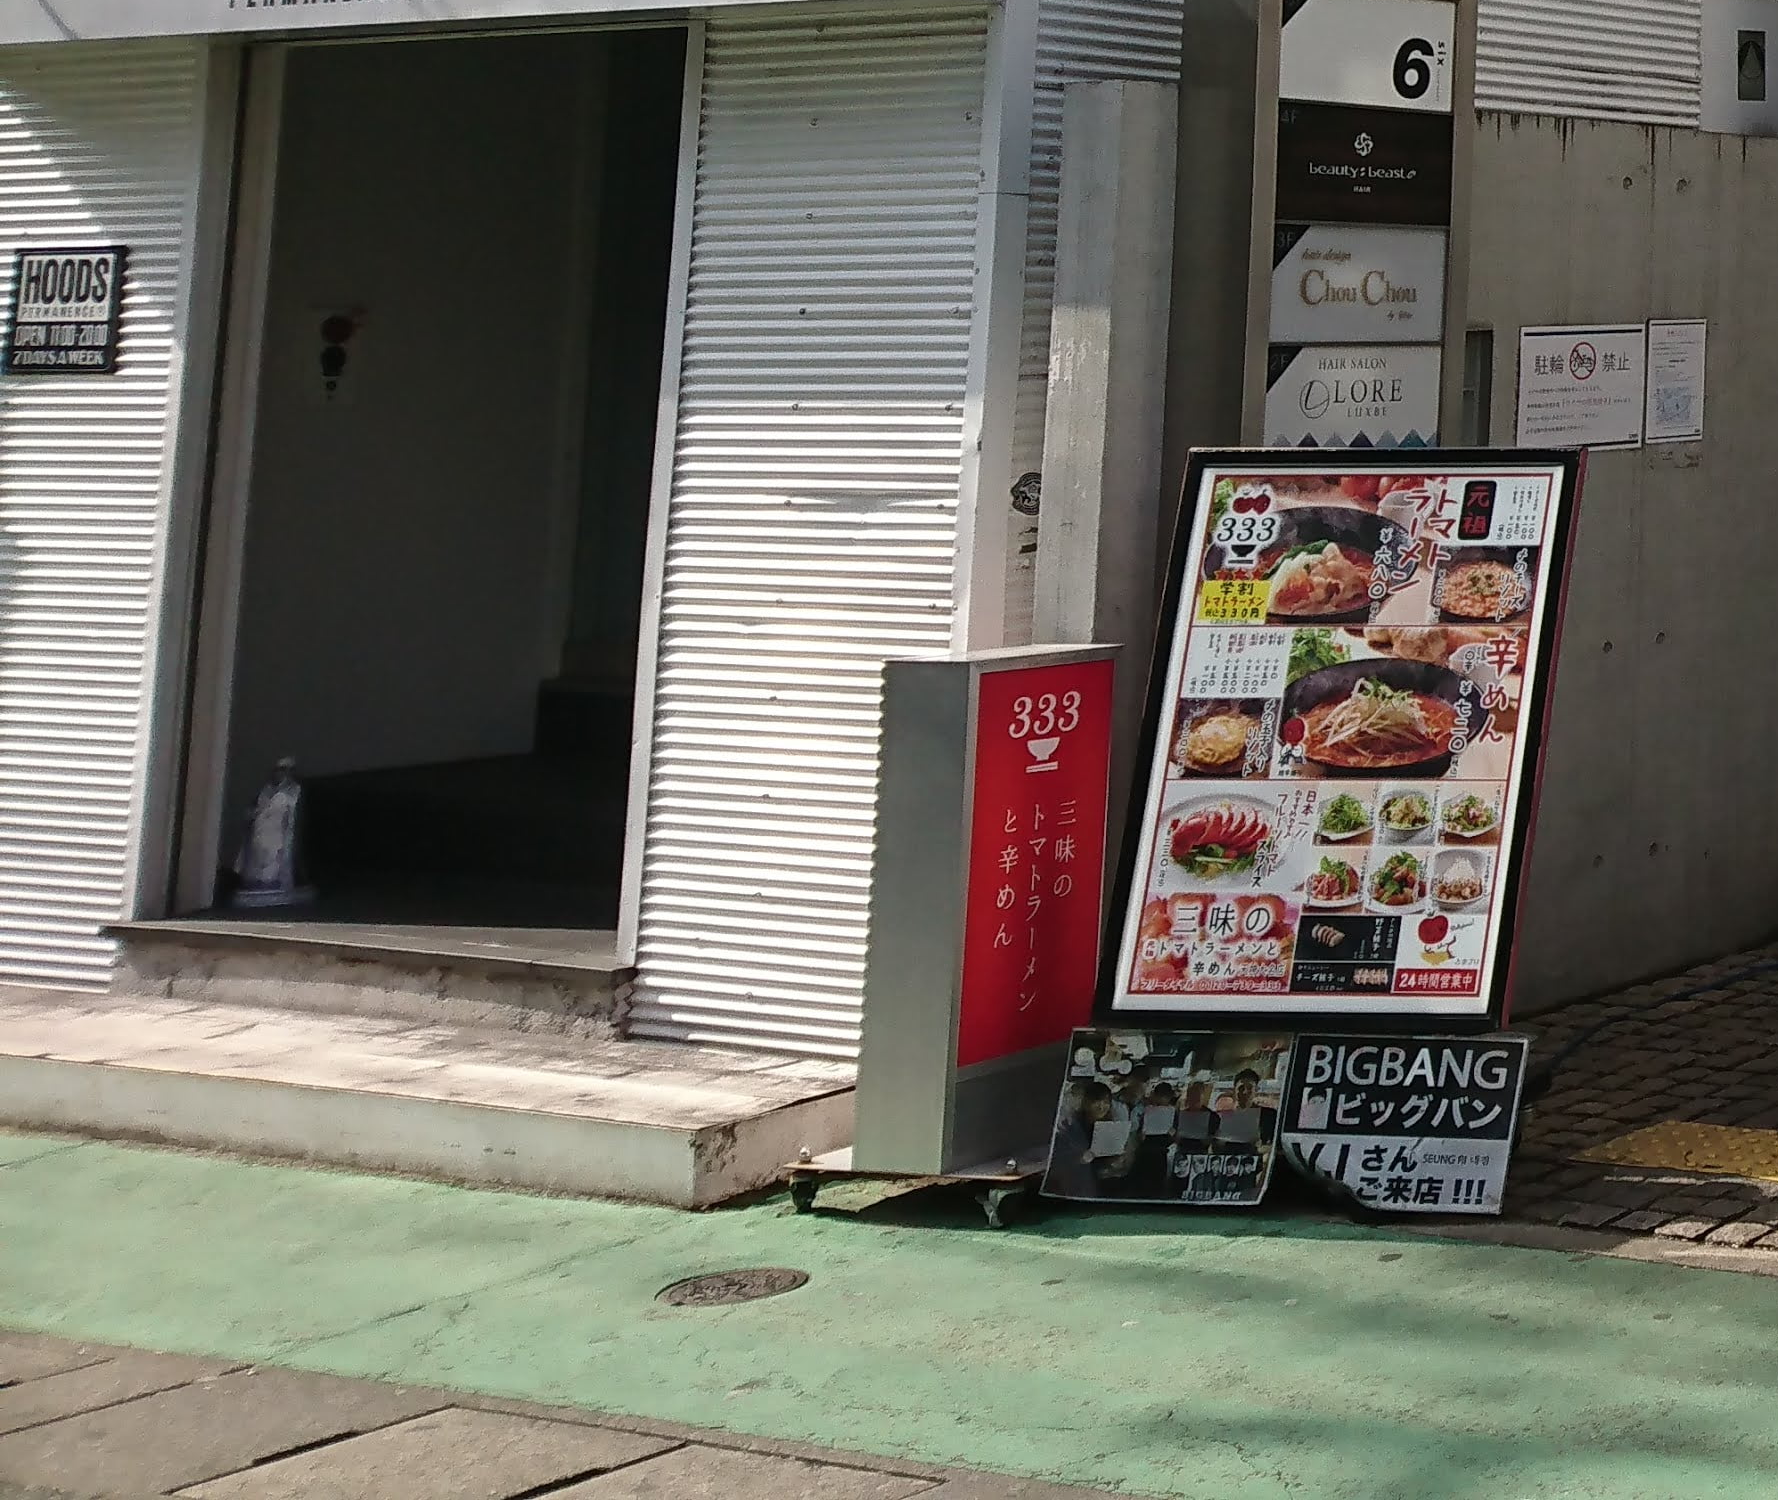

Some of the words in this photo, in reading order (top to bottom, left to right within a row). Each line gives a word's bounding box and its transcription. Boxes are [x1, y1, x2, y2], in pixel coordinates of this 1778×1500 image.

[1392, 37, 1435, 100] 6
[24, 257, 110, 305] HOODS
[1299, 268, 1358, 306] Chou
[1360, 269, 1418, 306] Chou
[14, 324, 47, 347] OPEN
[12, 350, 21, 366] 7
[68, 350, 104, 365] WEEK
[1318, 357, 1347, 371] HAIR
[1350, 357, 1387, 370] SALON
[1534, 354, 1565, 376] 駐輪
[1601, 351, 1631, 373] 禁止
[1332, 379, 1404, 404] LORE
[1216, 516, 1277, 543] 333
[1219, 582, 1254, 596] 学割
[1007, 689, 1083, 740] 333
[1052, 800, 1077, 899] 三味の
[992, 808, 1019, 949] と辛めん
[1018, 803, 1047, 1013] トマトラーメン
[1172, 902, 1272, 937] 三味の
[1192, 961, 1236, 977] 辛めん
[1305, 1043, 1511, 1091] BIGBANG
[1335, 1091, 1503, 1131] ビッグバン
[1361, 1144, 1418, 1174] さん
[1422, 1152, 1457, 1166] SEUNG
[1356, 1175, 1445, 1205] ご来店
